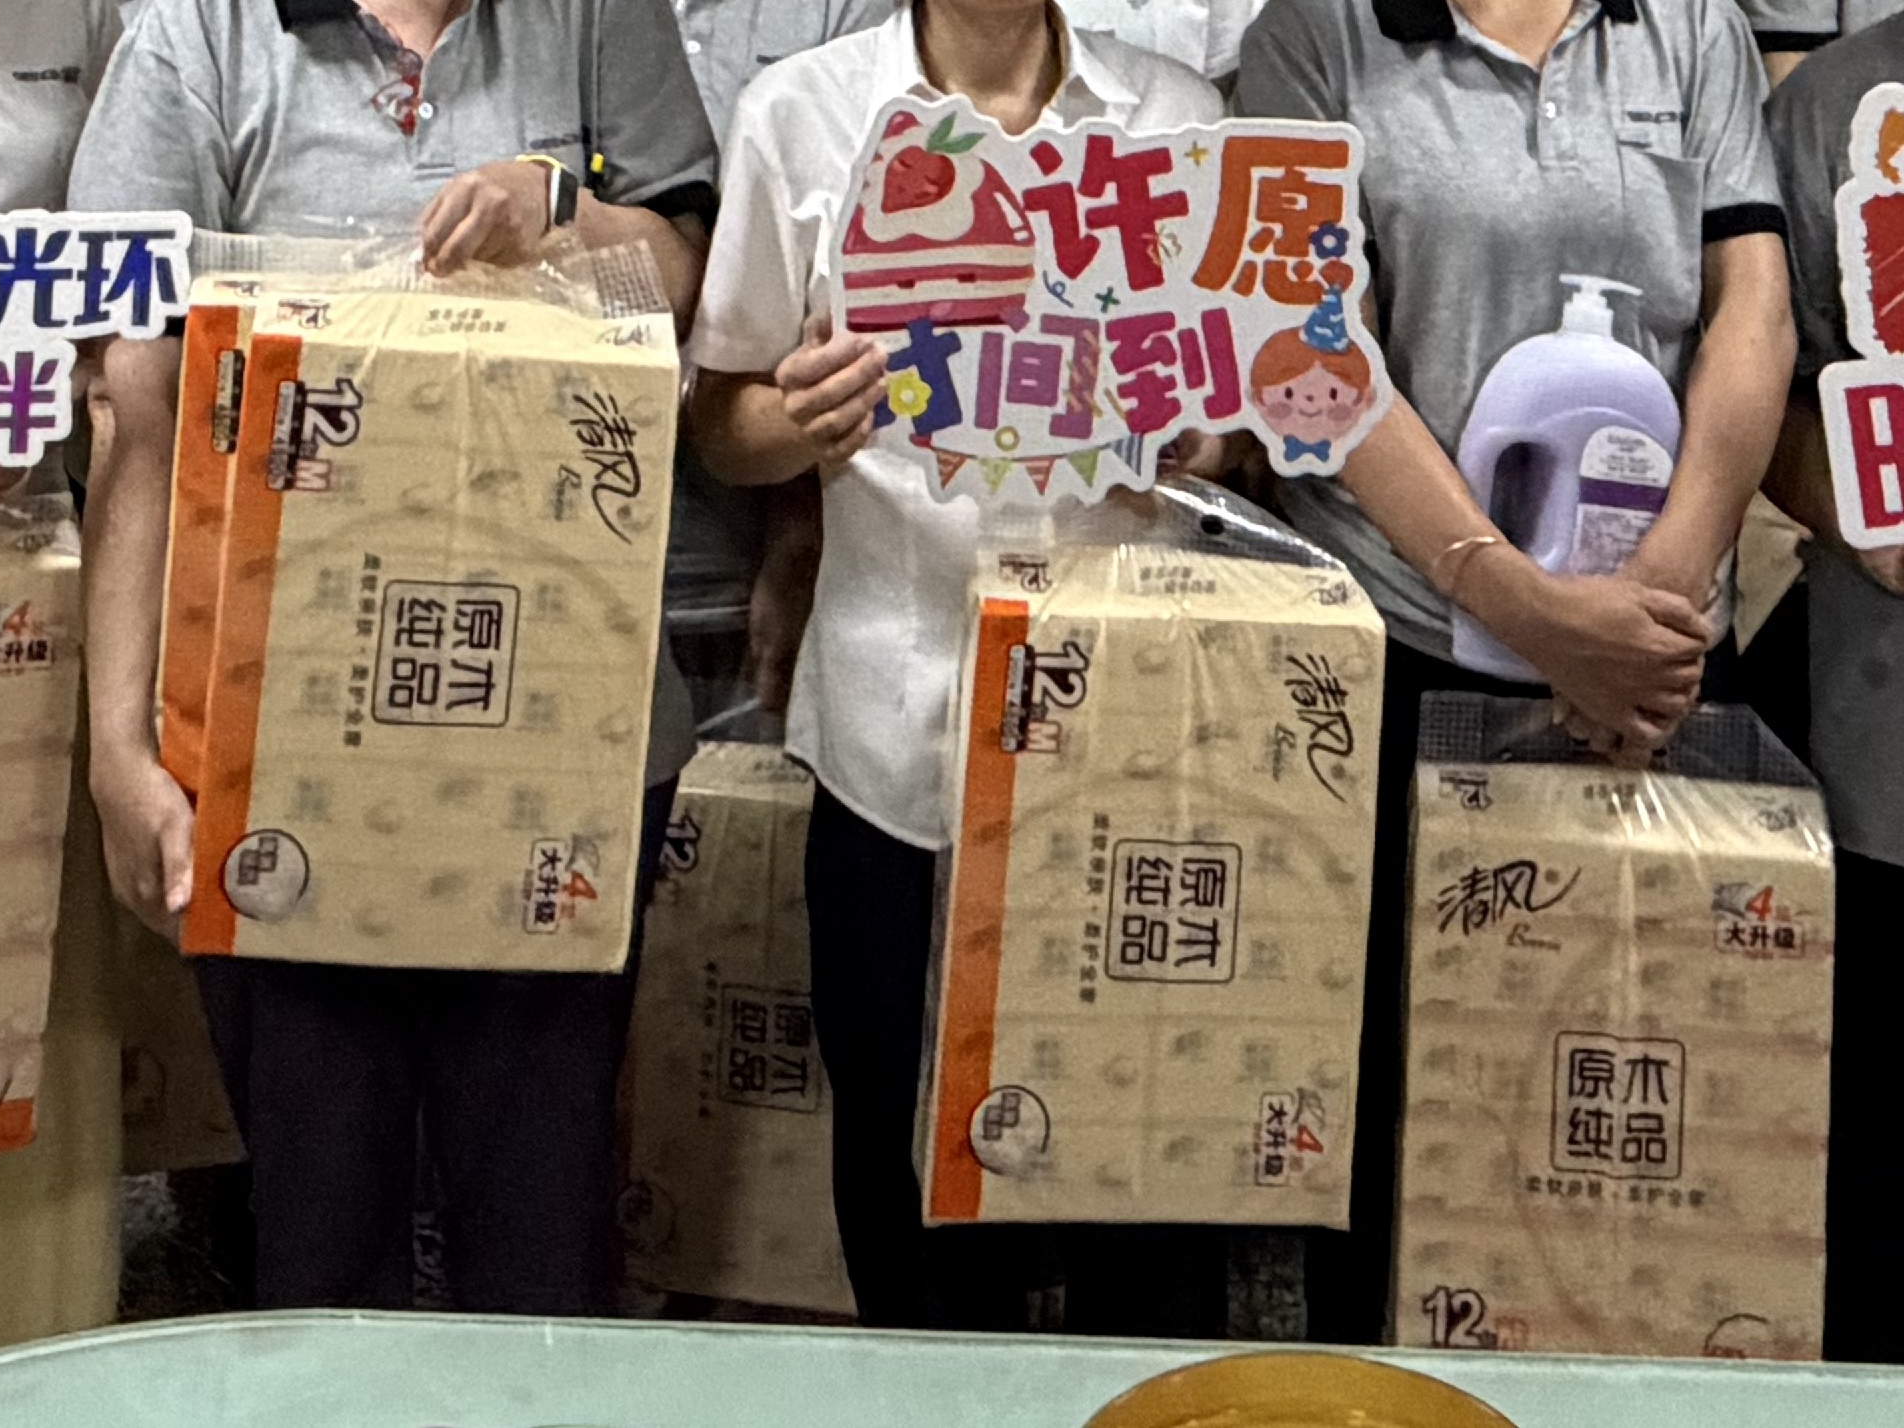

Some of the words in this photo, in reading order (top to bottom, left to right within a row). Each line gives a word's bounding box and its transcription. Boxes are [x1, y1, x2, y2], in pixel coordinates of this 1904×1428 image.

[1022, 134, 1351, 306] 许愿
[302, 376, 364, 447] 12
[572, 392, 642, 545] 清风
[3, 599, 32, 635] 4
[388, 596, 448, 710] 纯品
[447, 599, 504, 713] 原木
[1032, 640, 1091, 710] 12
[1286, 653, 1356, 803] 清风
[531, 843, 565, 926] 大升级
[563, 871, 598, 901] 4
[1119, 854, 1176, 967] 纯品
[1174, 857, 1227, 970] 原木
[1436, 860, 1582, 937] 清风
[1745, 885, 1774, 922] 4
[1567, 1048, 1671, 1105] 原木
[1296, 1125, 1324, 1154] 4
[1565, 1107, 1668, 1164] 纯品
[1421, 1285, 1487, 1350] 12
